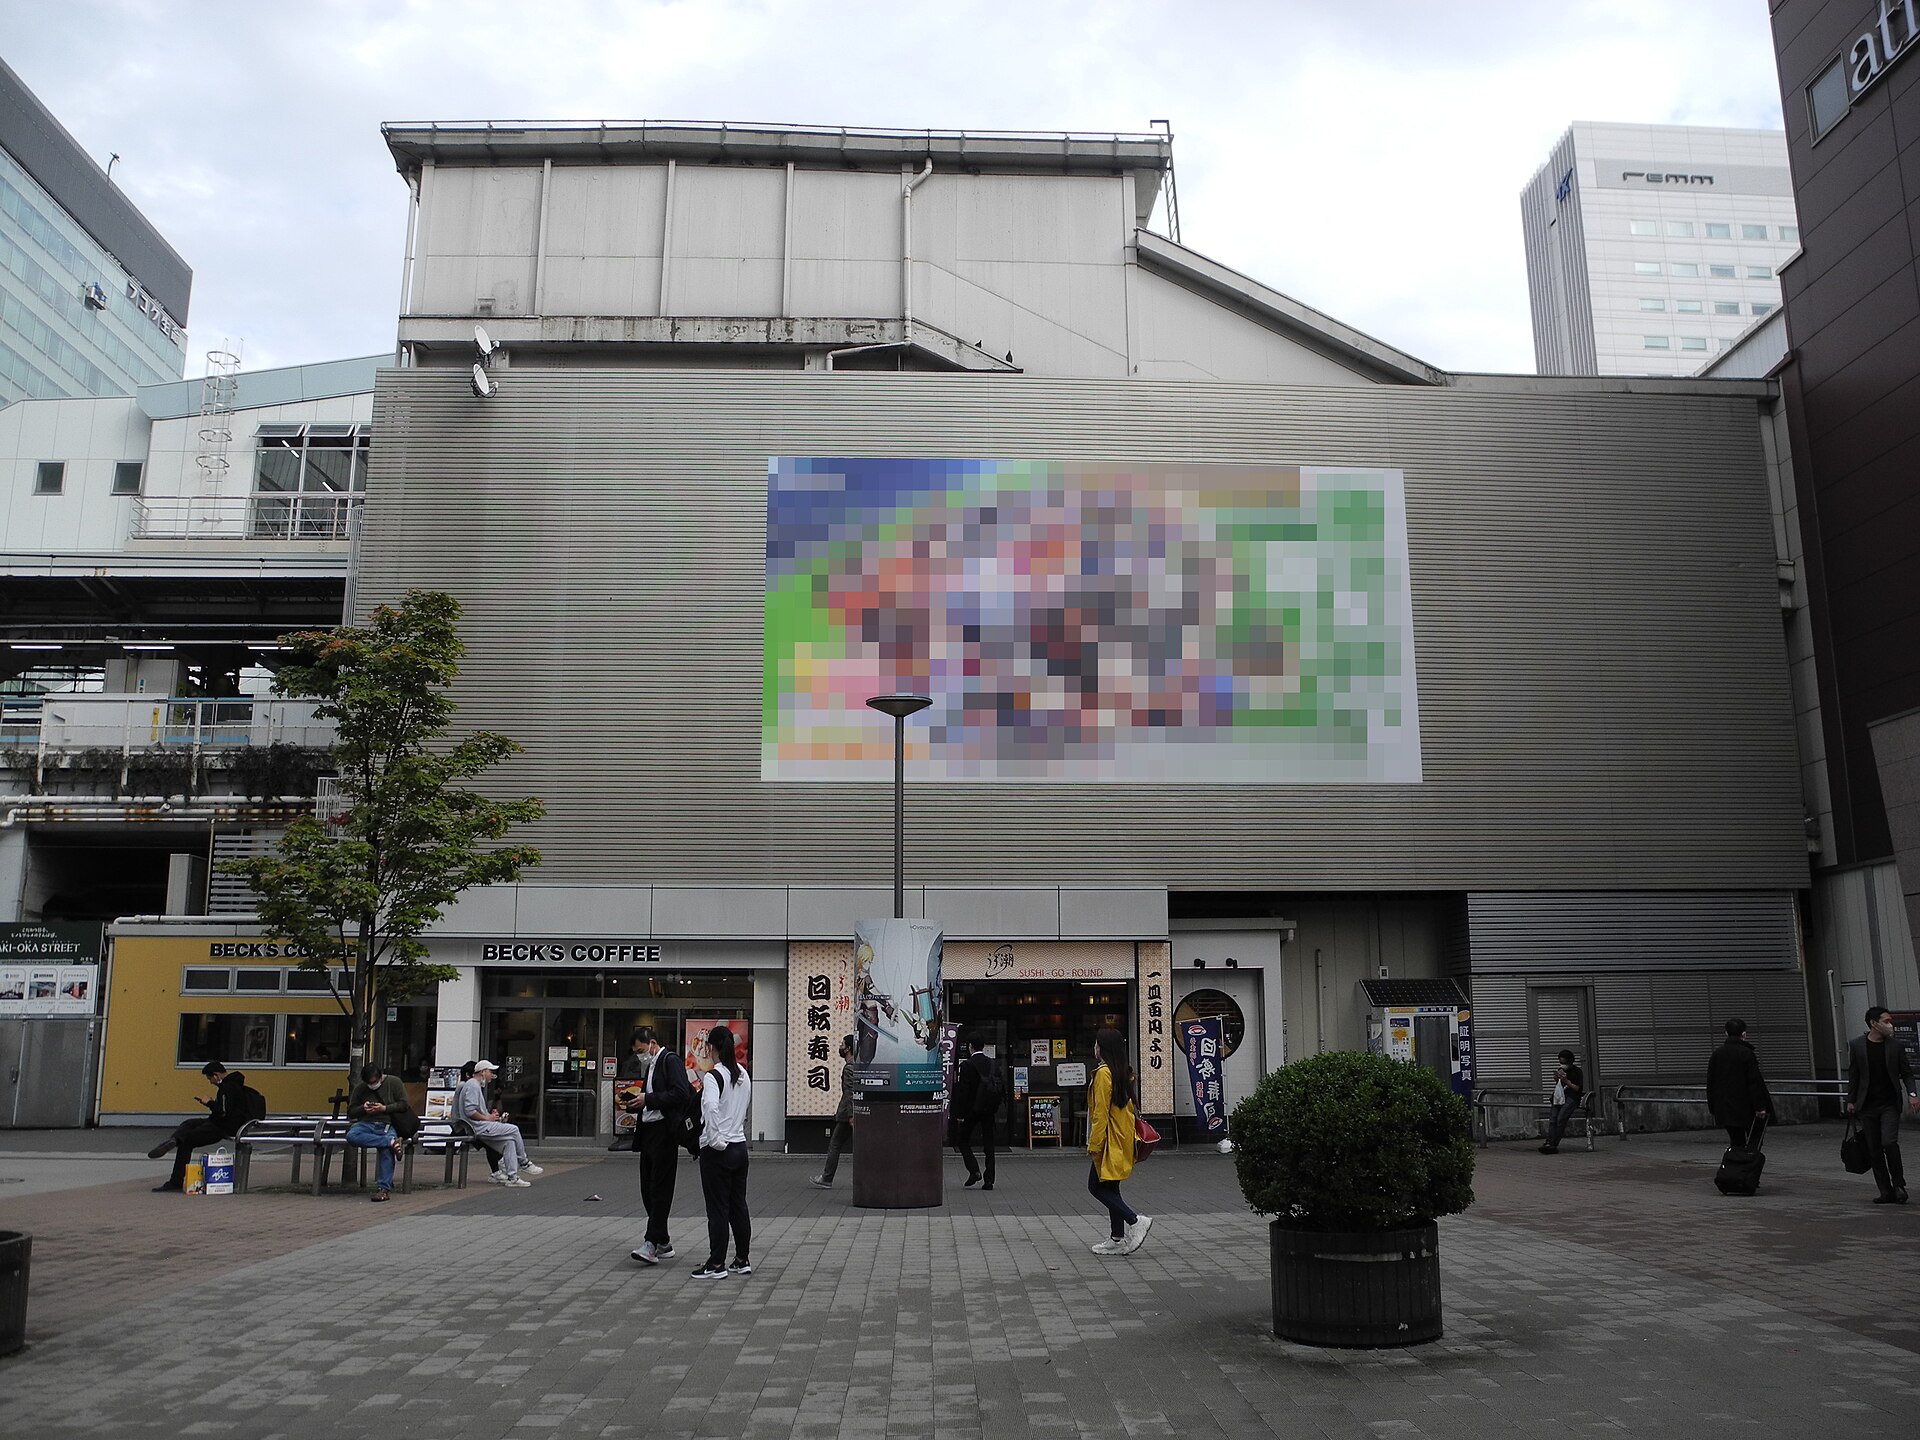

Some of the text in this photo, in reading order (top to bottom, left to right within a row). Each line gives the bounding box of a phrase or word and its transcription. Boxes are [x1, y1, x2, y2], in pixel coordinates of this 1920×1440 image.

[1623, 172, 1714, 186] remm
[41, 942, 81, 953] STREET
[210, 943, 279, 958] BECK'S
[482, 944, 661, 962] BECK'S COFFEE
[1019, 969, 1044, 978] SUSHI
[1051, 969, 1065, 978] GO
[1071, 969, 1104, 978] ROUND
[1147, 971, 1163, 1070] 一皿百円より
[807, 974, 831, 1092] 回転寿司
[1459, 1025, 1472, 1081] 証明写真
